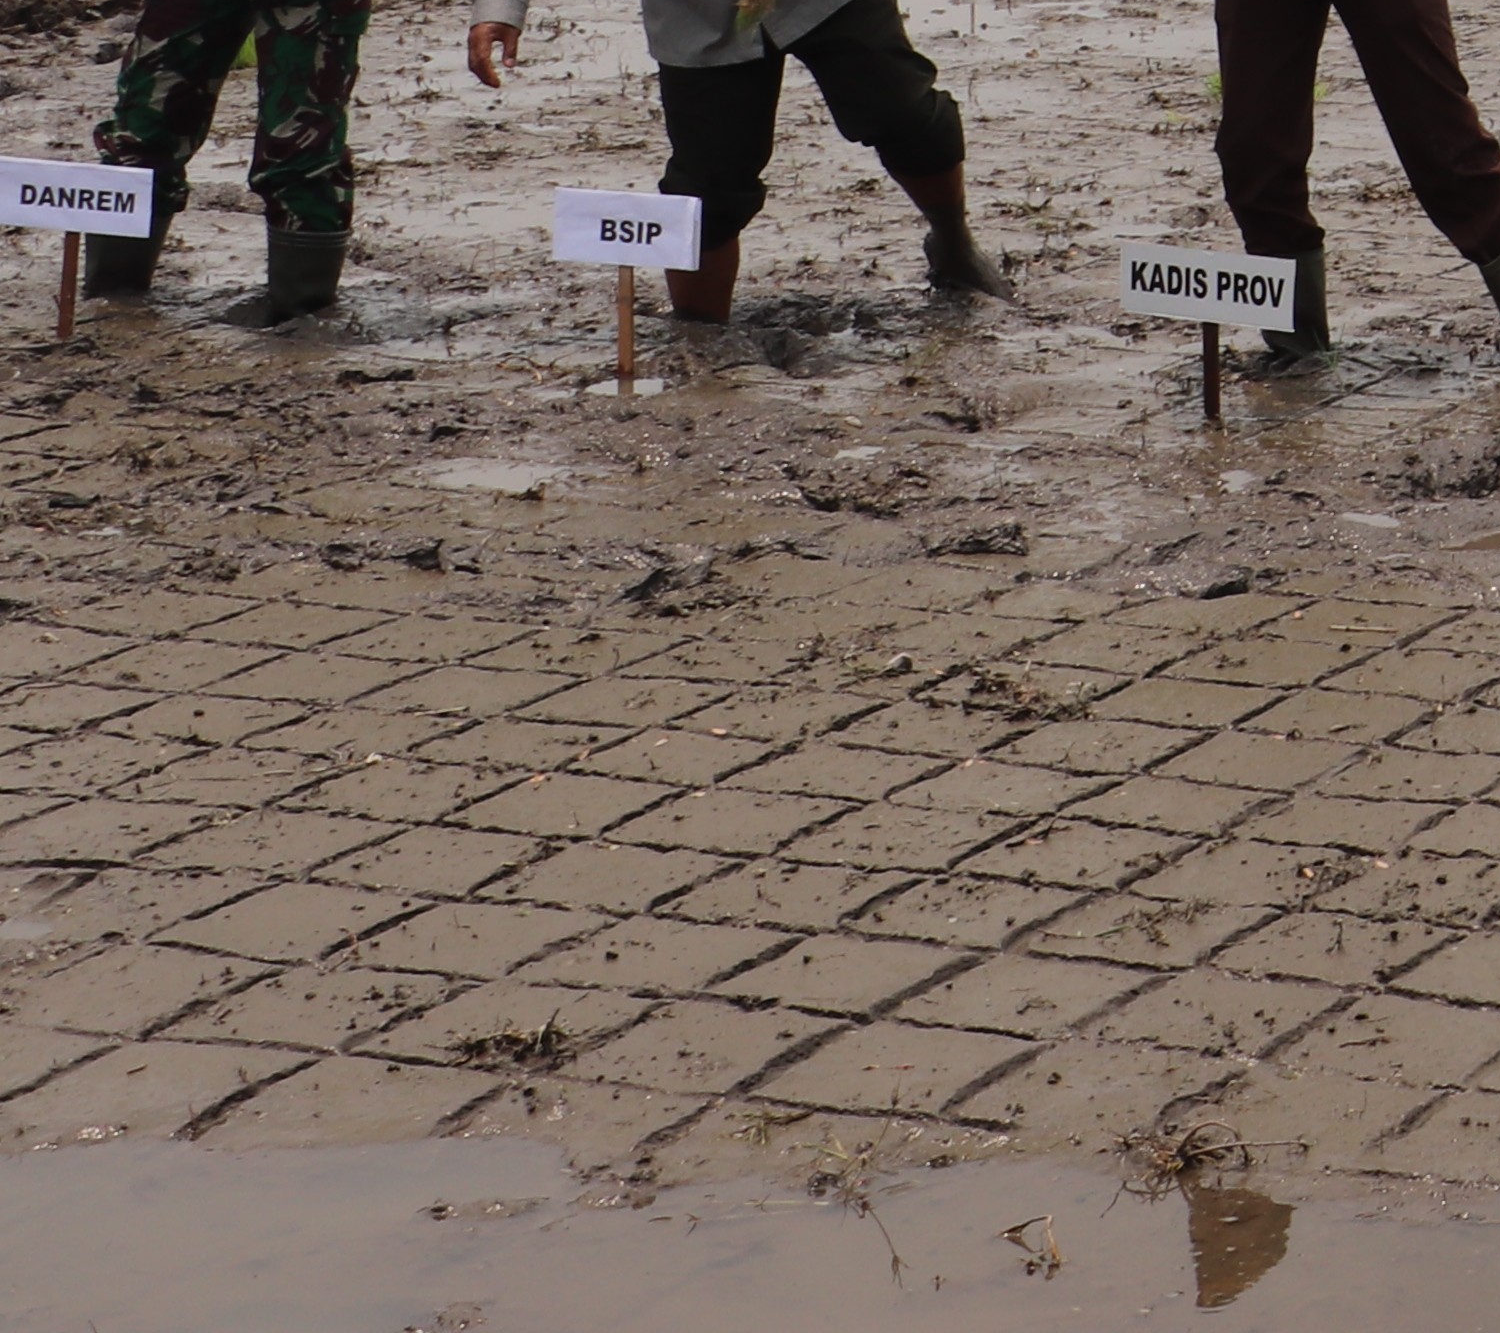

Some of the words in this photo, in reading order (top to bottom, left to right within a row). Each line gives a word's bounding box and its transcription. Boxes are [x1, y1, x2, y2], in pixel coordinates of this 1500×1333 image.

[20, 183, 136, 214] DANREM
[600, 218, 663, 245] BSIP
[1130, 260, 1208, 300] KADIS
[1216, 270, 1285, 309] PROV
